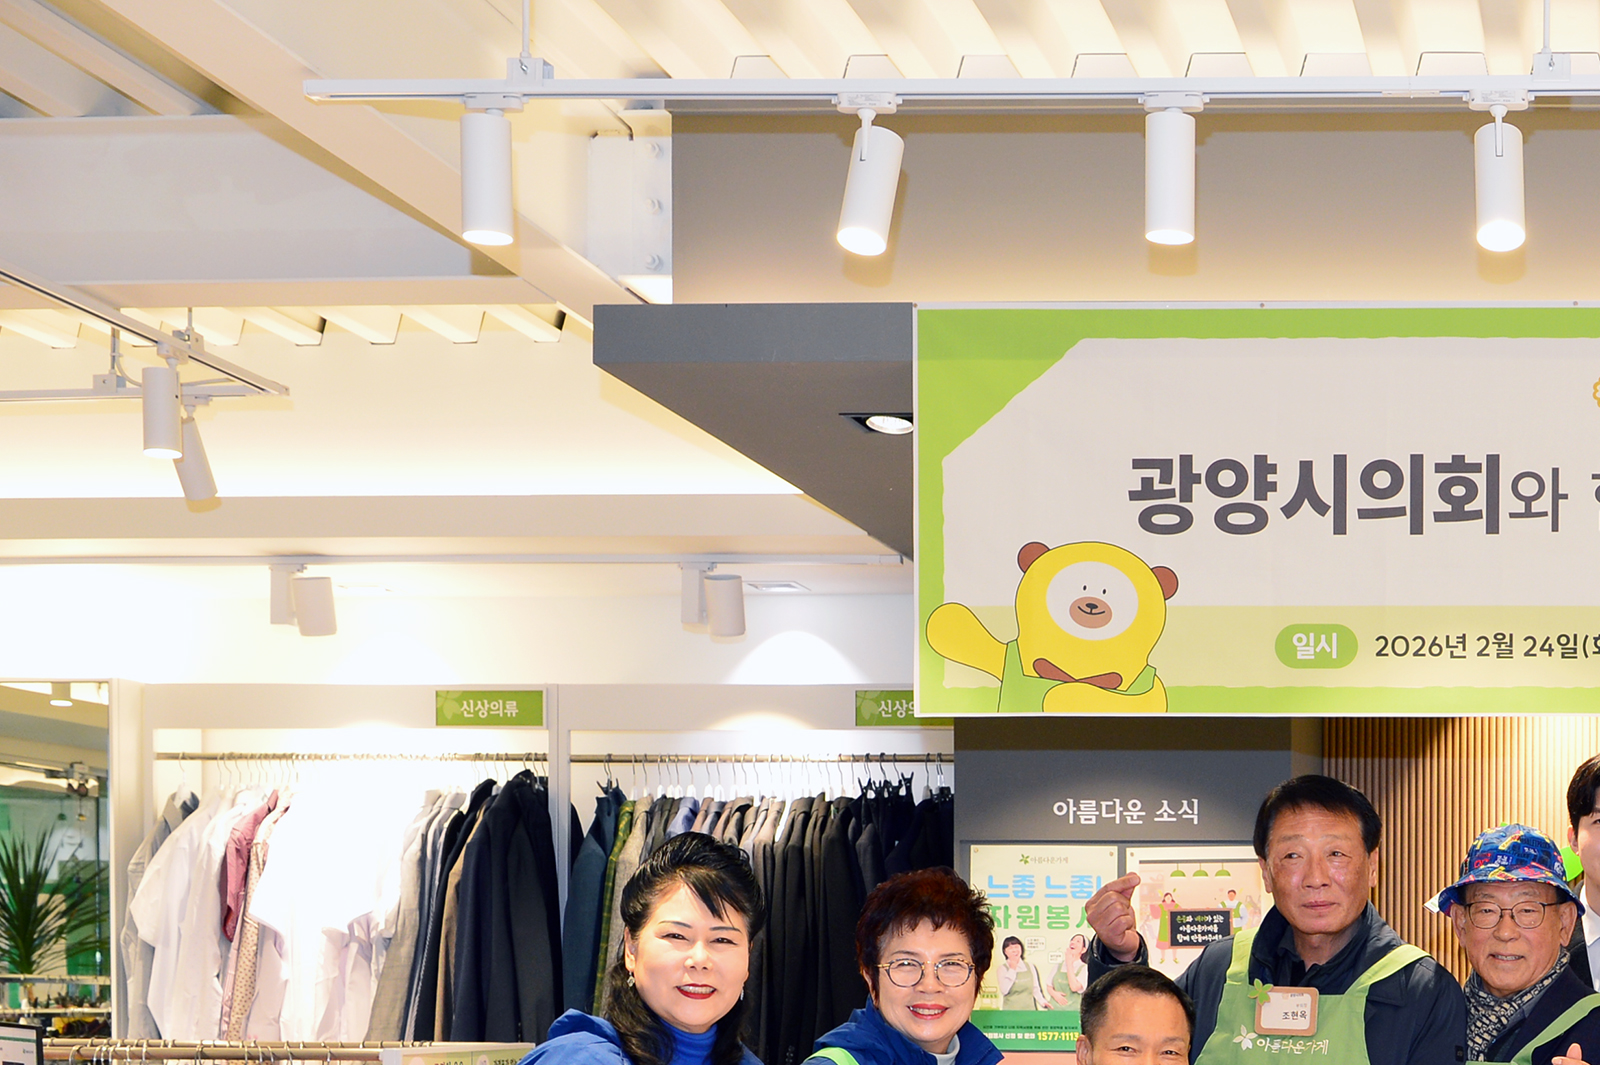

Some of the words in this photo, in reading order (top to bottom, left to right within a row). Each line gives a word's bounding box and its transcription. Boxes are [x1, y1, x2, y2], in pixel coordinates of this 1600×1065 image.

[1127, 454, 1569, 537] 광양시의회와
[1292, 632, 1338, 660] 일시
[1374, 633, 1467, 660] 2026년
[1476, 632, 1514, 660] 2월
[460, 699, 519, 719] 신상의류
[1053, 798, 1146, 825] 아름다운
[1154, 798, 1199, 826] 소식
[1030, 856, 1069, 865] 아름다운가게
[1282, 1010, 1308, 1021] 조현옥
[1256, 1037, 1330, 1055] 아름다운가게
